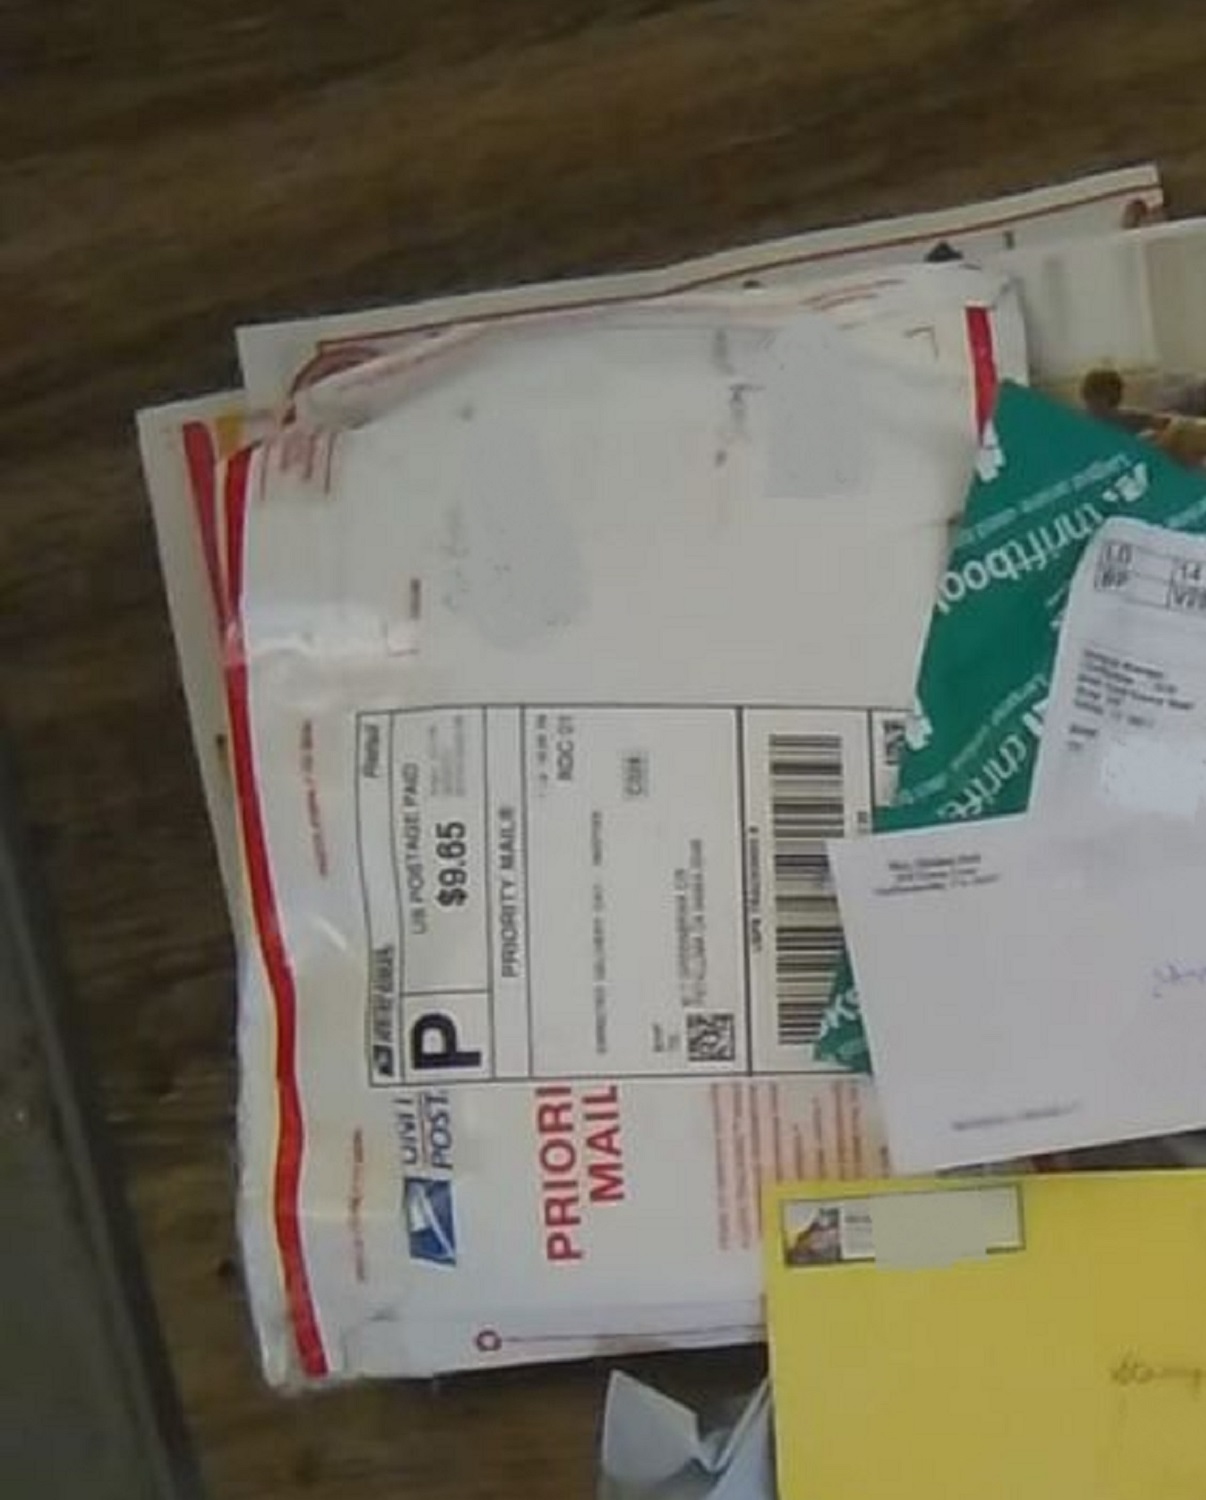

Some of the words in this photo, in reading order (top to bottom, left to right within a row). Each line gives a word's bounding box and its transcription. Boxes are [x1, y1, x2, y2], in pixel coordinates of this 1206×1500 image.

[405, 811, 425, 904] POSTAGE
[435, 820, 469, 909] $9.65
[499, 878, 519, 979] PRIORITY
[409, 1012, 483, 1072] P
[423, 1090, 453, 1170] POST
[535, 1084, 584, 1262] PRIORI
[582, 1085, 626, 1203] MAIL
